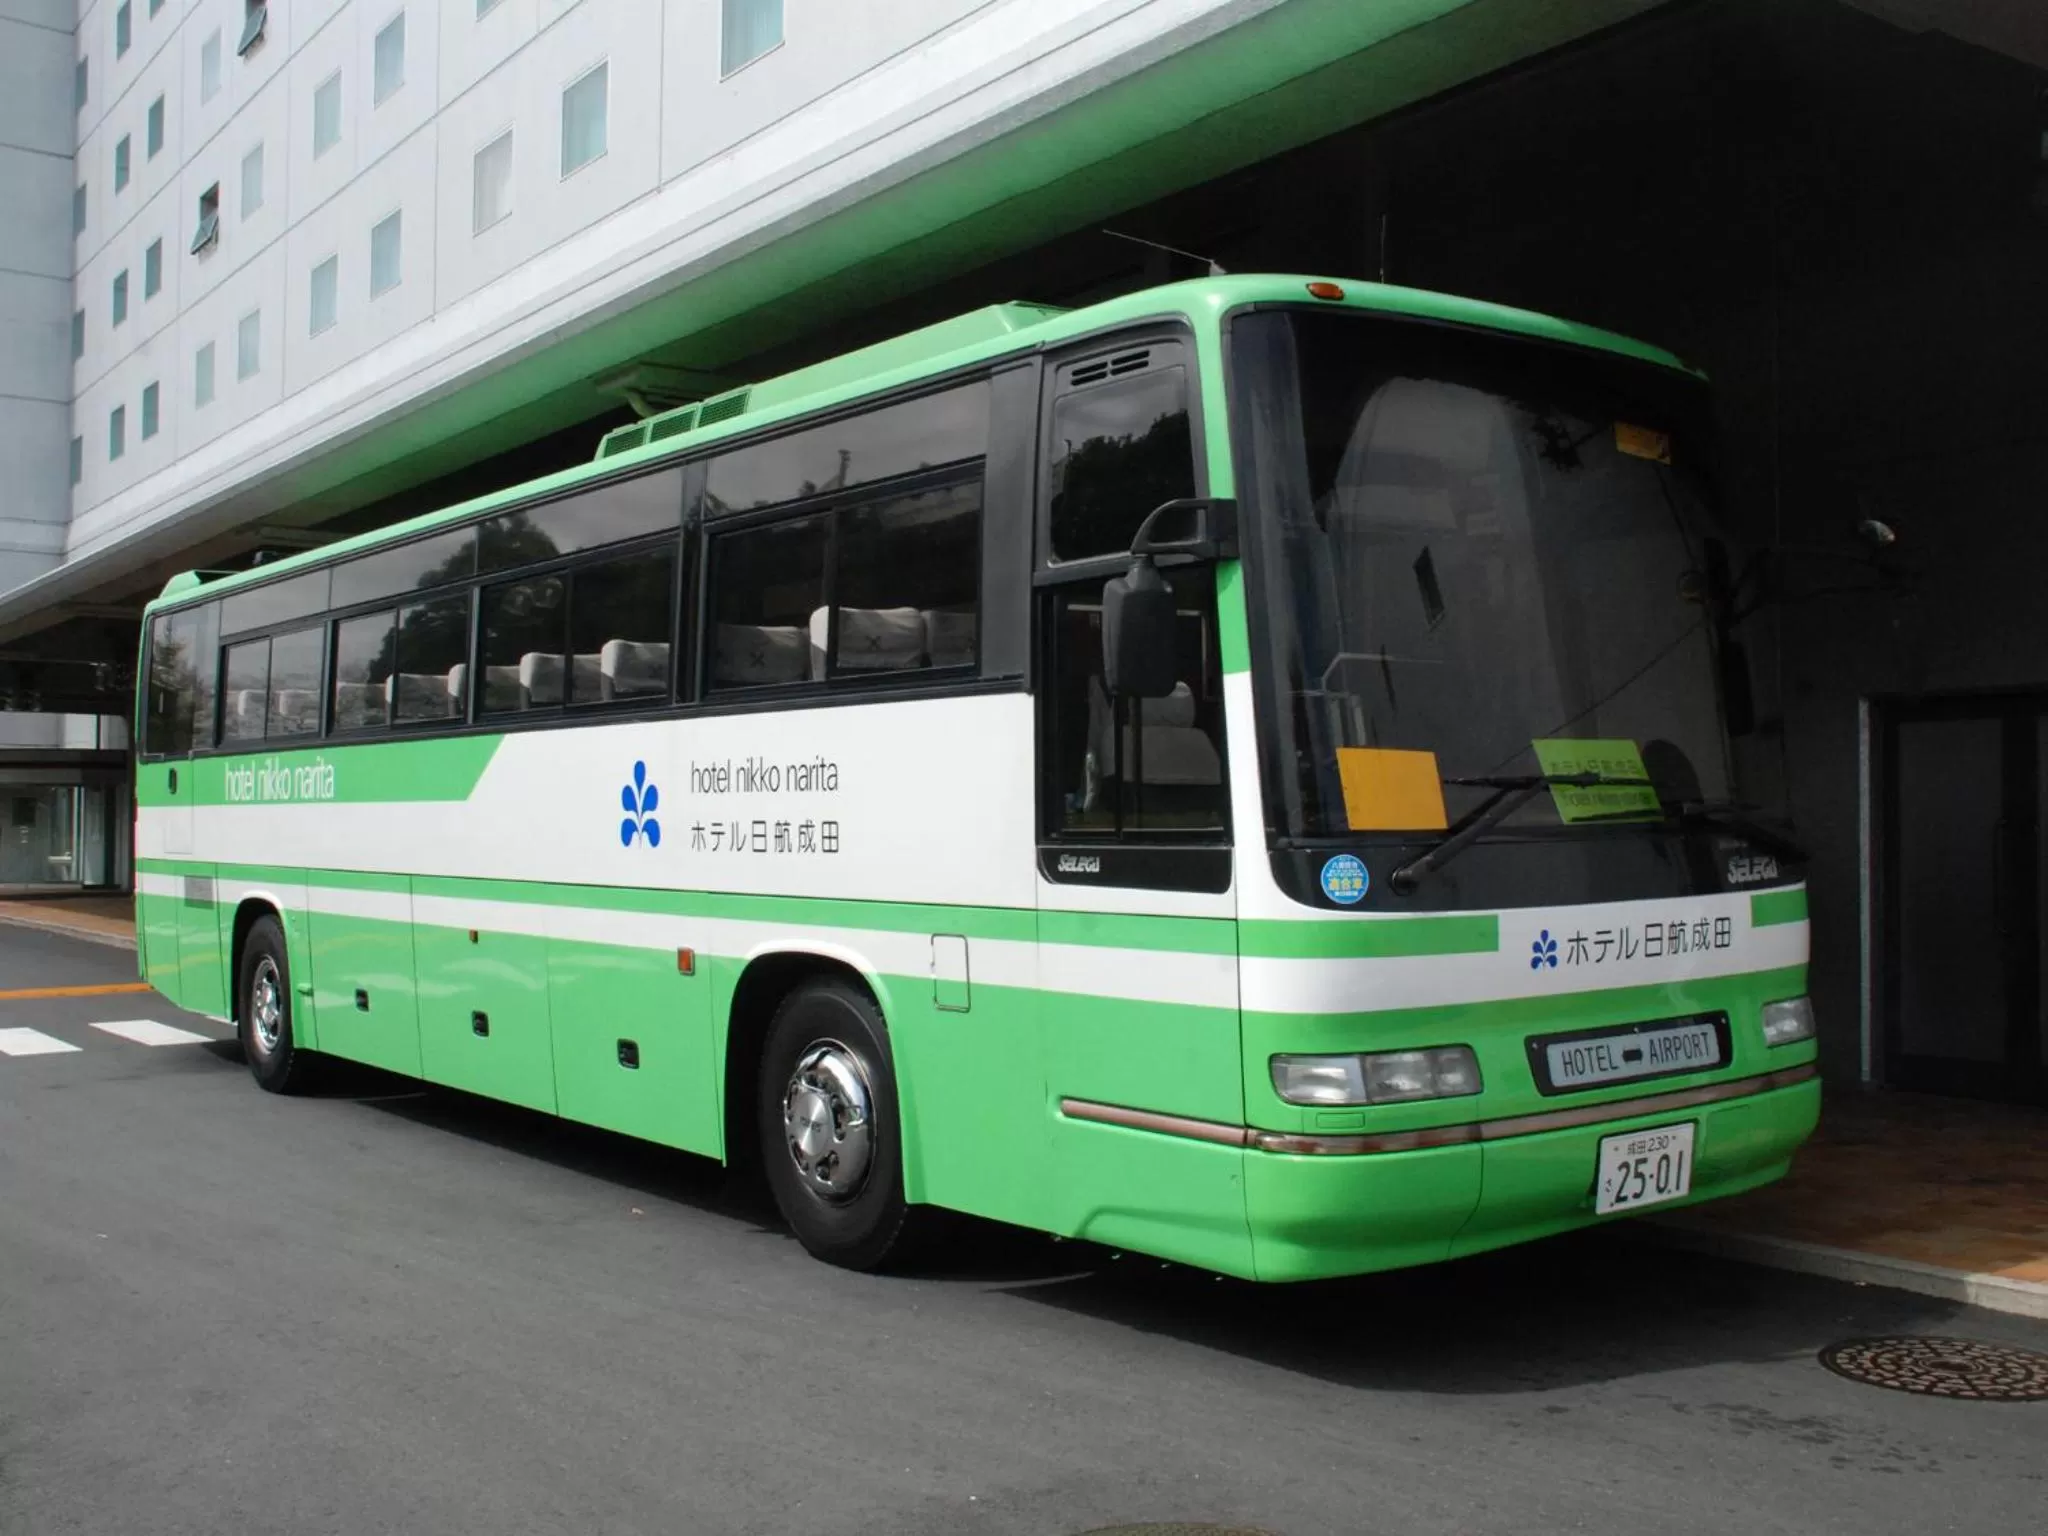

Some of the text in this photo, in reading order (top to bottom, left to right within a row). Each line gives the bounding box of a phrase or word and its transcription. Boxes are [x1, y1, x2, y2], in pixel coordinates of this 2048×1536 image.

[225, 755, 335, 801] hotel nikko narita
[691, 755, 838, 794] hotel nikko narita
[691, 819, 839, 853] ホテル日航成田
[1566, 917, 1731, 966] ホテル日航成田
[1561, 1032, 1710, 1078] HOTEL AIRPORT
